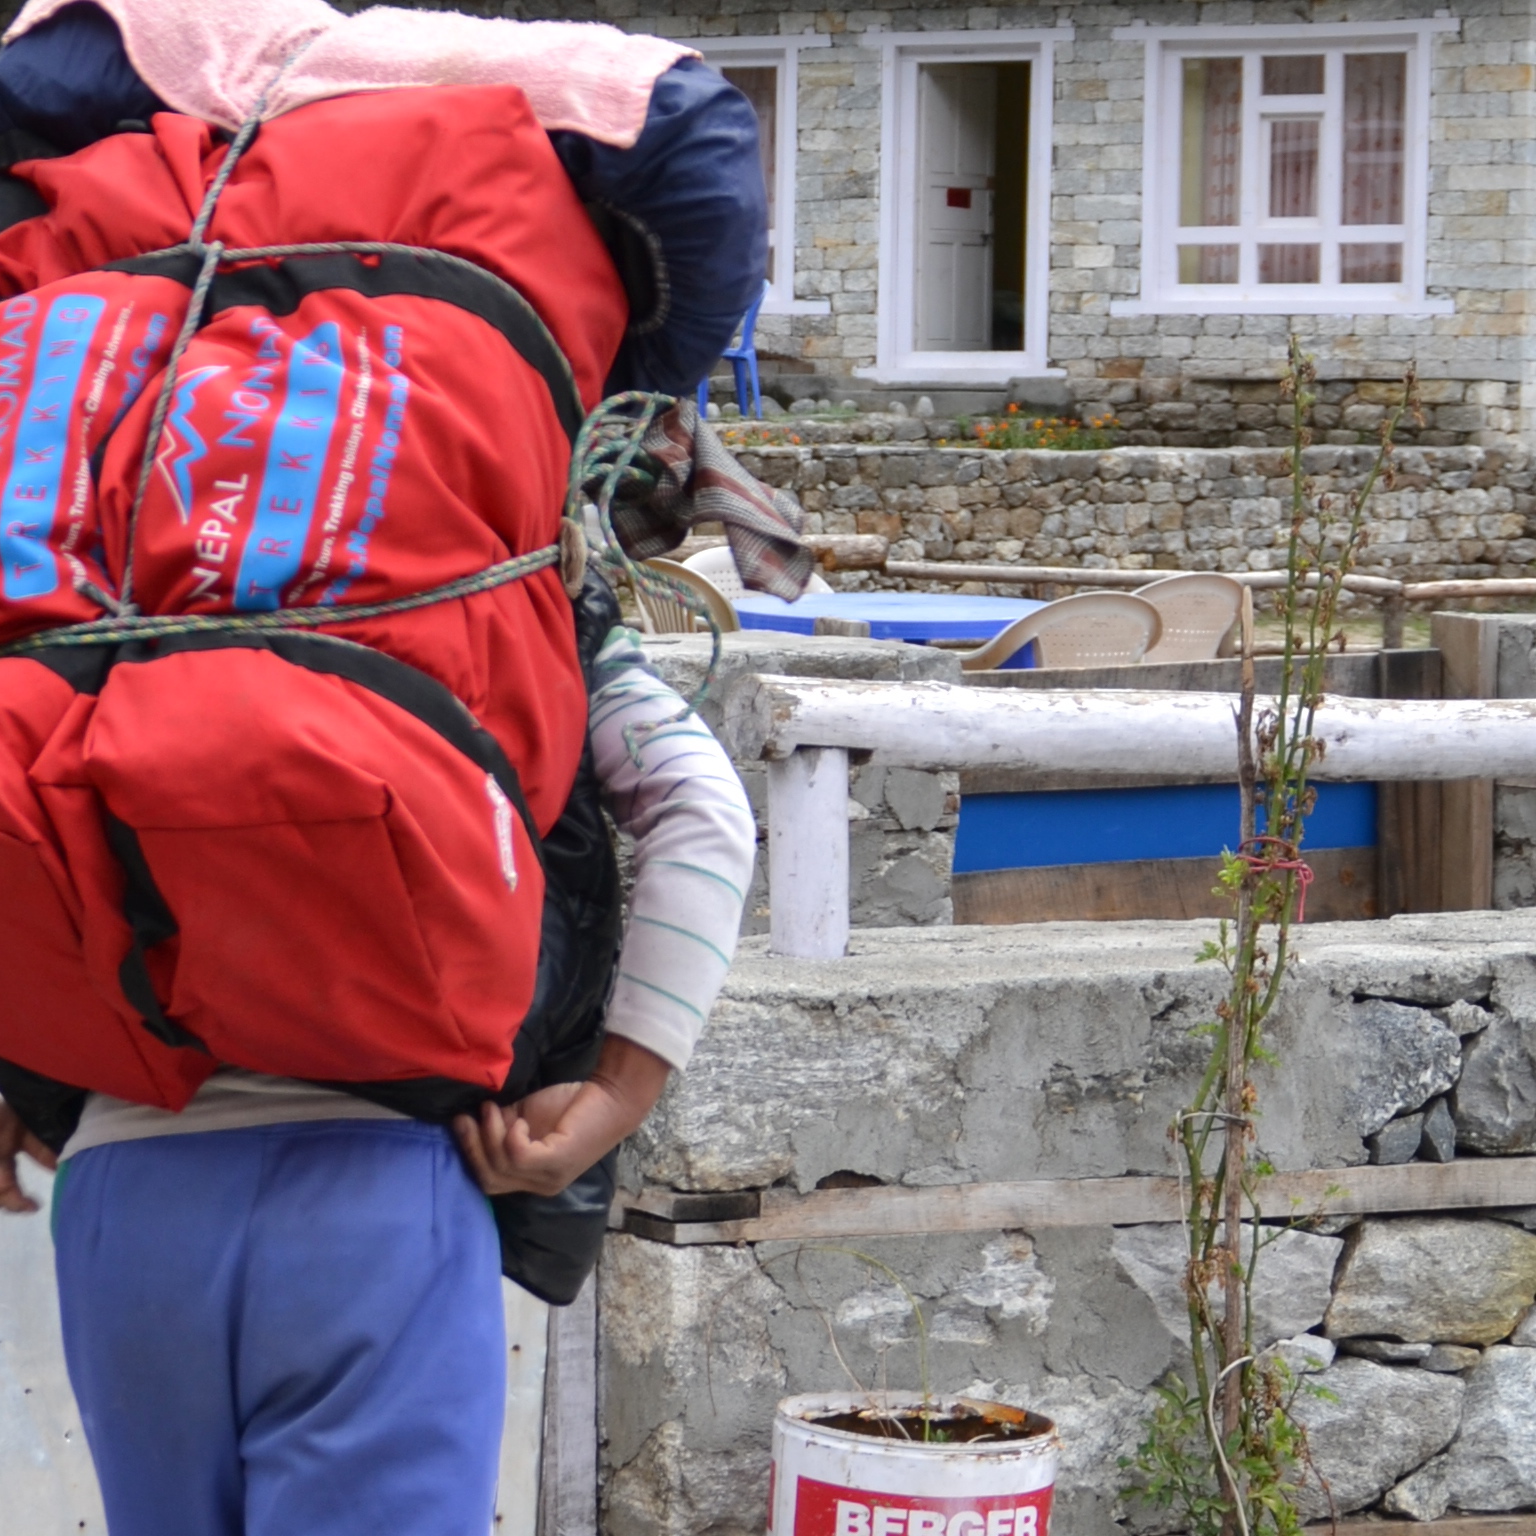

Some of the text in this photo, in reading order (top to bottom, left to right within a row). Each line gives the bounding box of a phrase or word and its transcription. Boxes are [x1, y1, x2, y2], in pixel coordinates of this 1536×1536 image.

[84, 359, 116, 413] Climbing
[7, 306, 90, 580] TREKKING
[340, 421, 364, 470] Holidays,
[323, 470, 355, 532] Trekking
[187, 473, 248, 602] NEPAL
[314, 536, 337, 569] Tours,
